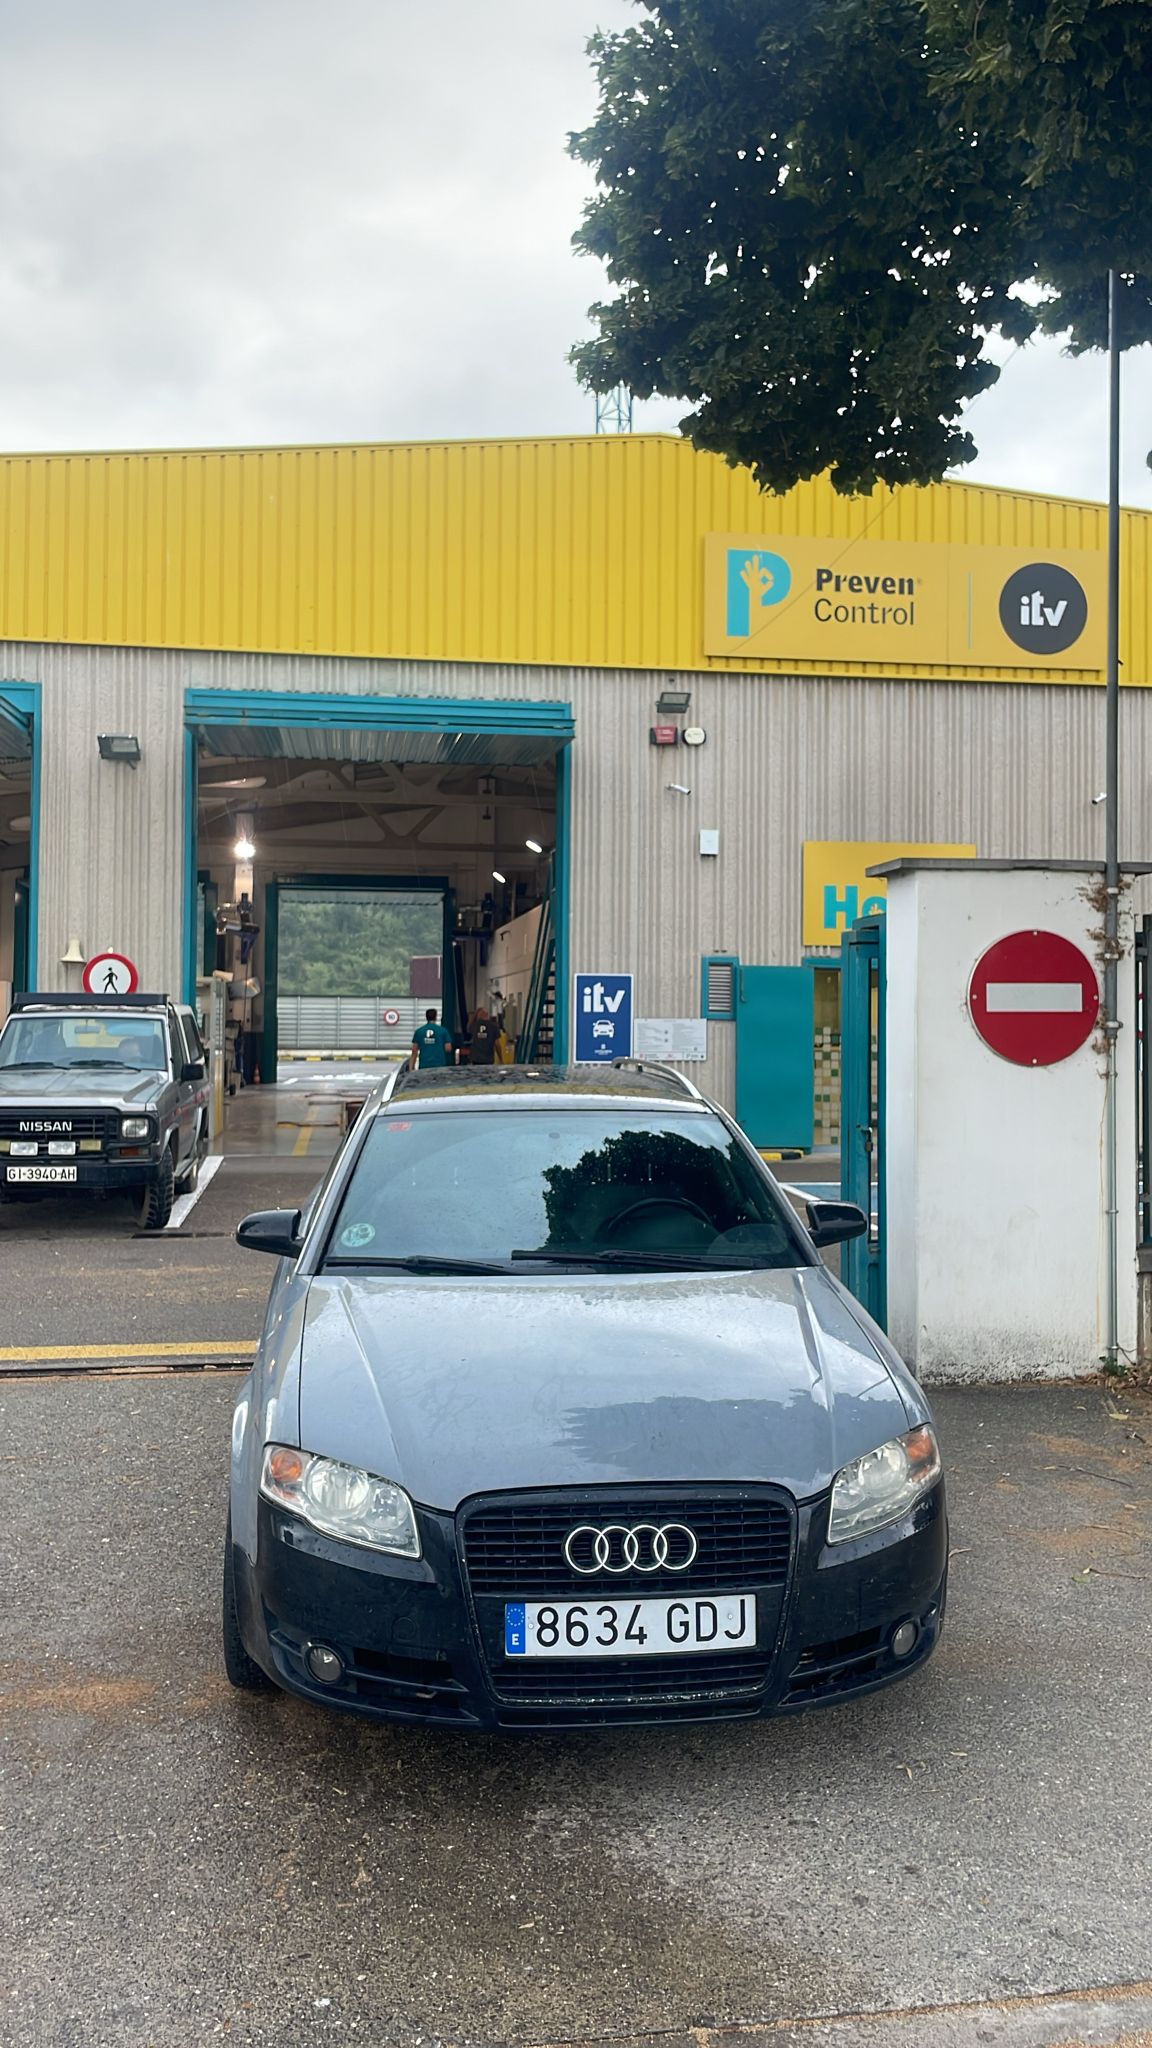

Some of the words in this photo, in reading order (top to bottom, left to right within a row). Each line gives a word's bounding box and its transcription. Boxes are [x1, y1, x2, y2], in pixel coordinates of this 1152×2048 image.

[815, 568, 914, 596] Preven
[814, 598, 915, 625] Control
[1020, 590, 1068, 626] itv
[583, 982, 625, 1013] itv
[19, 1121, 72, 1132] NISSAN
[536, 1604, 648, 1648] 8634
[666, 1599, 746, 1644] GDJ
[511, 1633, 519, 1646] E
